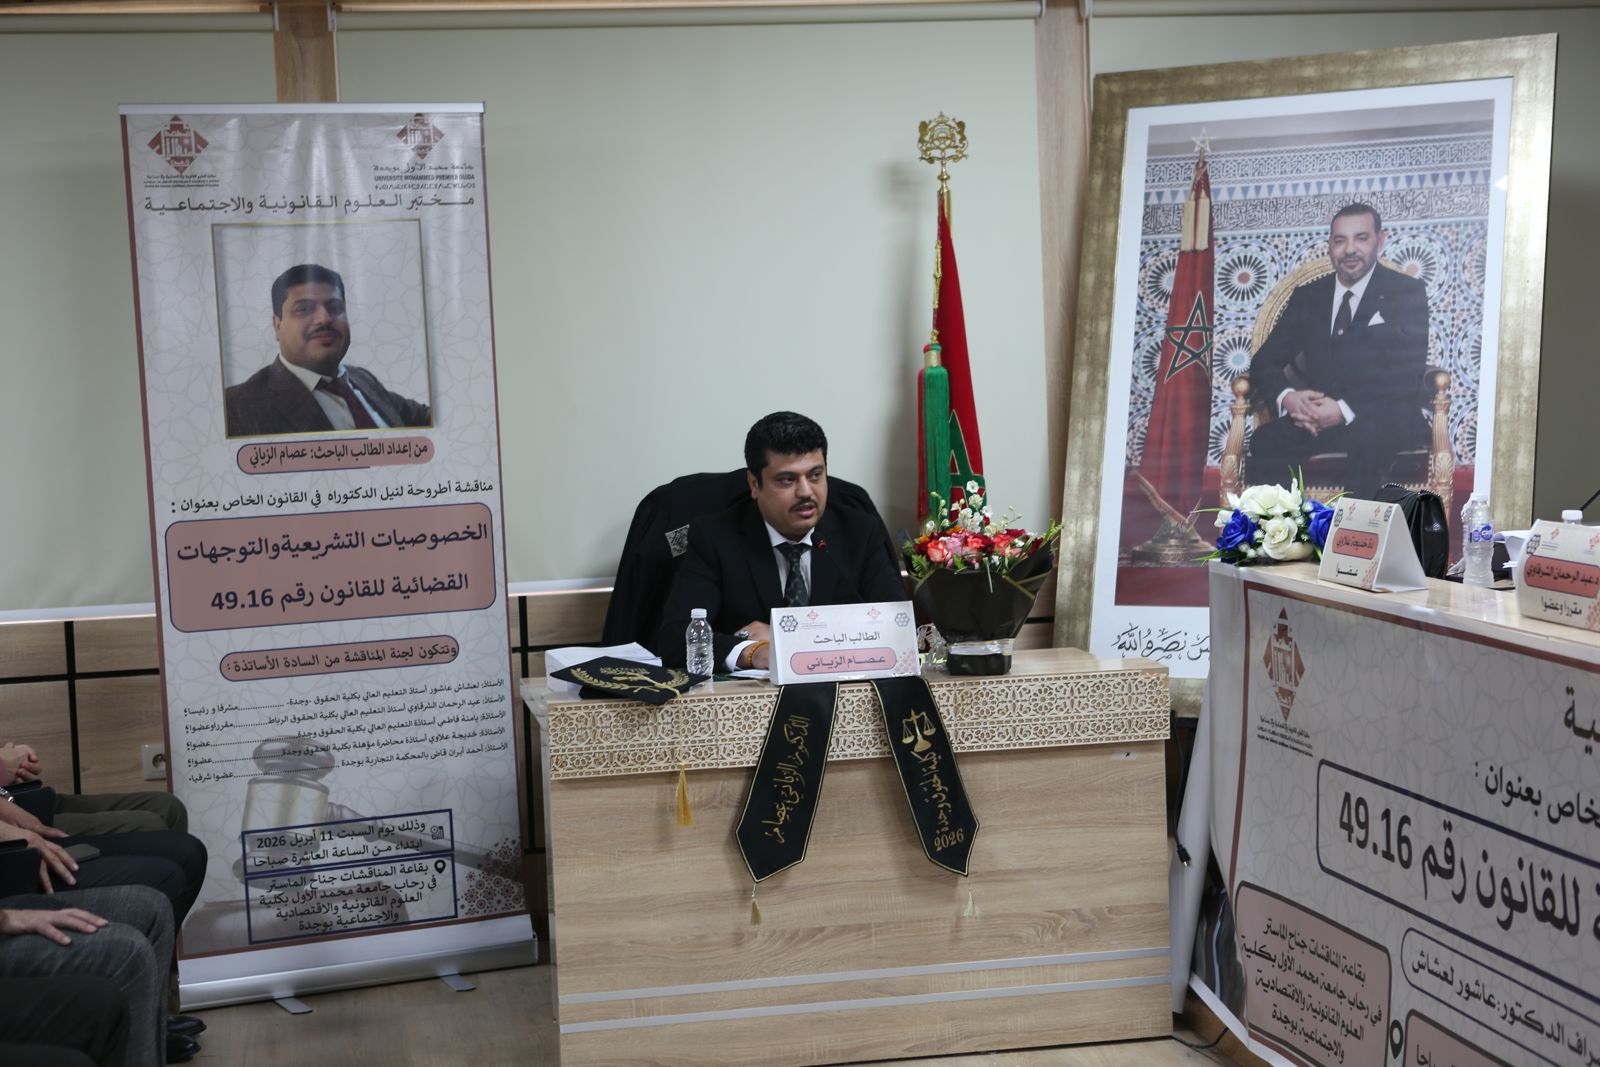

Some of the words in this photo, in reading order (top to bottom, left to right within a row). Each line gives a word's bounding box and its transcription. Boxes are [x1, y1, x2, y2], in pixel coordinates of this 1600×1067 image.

[144, 196, 254, 215] والاجتماعية
[259, 194, 338, 214] القانونية
[344, 193, 402, 214] العلوم
[406, 194, 475, 210] مختبر
[249, 447, 277, 468] الزياني
[279, 446, 308, 465] عصام
[310, 444, 348, 462] الباحث:
[350, 443, 385, 461] الطالب
[387, 442, 412, 458] إعداد
[415, 443, 428, 458] من
[380, 486, 404, 501] لنيل
[407, 480, 452, 498] أطروحة
[454, 479, 493, 493] مناقشة
[222, 494, 264, 511] الخاص
[267, 491, 308, 508] القانون
[311, 490, 322, 508] في
[327, 486, 377, 504] الدكتوراه
[180, 499, 219, 513] بعنوان
[371, 523, 488, 551] الخصوصيات
[320, 579, 385, 606] للقانون
[392, 573, 469, 599] القضائية
[211, 588, 274, 610] 49.16
[280, 582, 314, 612] رقم
[813, 633, 847, 645] الباحث
[848, 631, 881, 645] الطالب
[344, 649, 385, 663] المناقشة
[390, 646, 414, 660] لجنة
[419, 643, 457, 658] وتتكون
[234, 656, 279, 672] الأساتذة
[283, 655, 320, 668] السادة
[324, 654, 340, 667] من
[807, 656, 846, 672] الزياني
[847, 655, 886, 668] عصام
[342, 692, 361, 701] بكلية
[362, 691, 380, 701] العالي
[382, 688, 407, 699] التعليم
[409, 685, 427, 695] أستاذ
[430, 685, 452, 695] عاشور
[313, 695, 341, 705] الحقوق
[387, 703, 406, 713] أستاذ
[290, 713, 318, 723] الحقوق
[319, 710, 338, 720] بكلية
[340, 709, 358, 720] العالي
[360, 707, 386, 717] التعليم
[318, 726, 346, 737] الحقوق
[347, 725, 365, 735] بكلية
[367, 723, 386, 734] العالي
[387, 720, 412, 731] التعليم
[303, 745, 331, 756] الحقوق
[332, 743, 351, 752] بكلية
[1485, 765, 1542, 817] بعنوان
[1547, 792, 1600, 829] خاص
[337, 825, 374, 840] السبت
[378, 826, 395, 837] يوم
[398, 819, 426, 832] وذلك
[1339, 791, 1413, 870] 49.16
[256, 835, 286, 848] 2026
[289, 829, 317, 847] أبريل
[320, 830, 334, 841] 11
[933, 827, 965, 852] 2026
[291, 849, 328, 866] العاشرة
[332, 845, 369, 857] الساعة
[372, 844, 392, 856] من
[253, 856, 288, 868] صباحا
[400, 862, 429, 875] بقاعة
[1422, 819, 1467, 904] رقم
[340, 865, 397, 881] المناقشات
[266, 876, 306, 893] الماستر
[310, 874, 337, 889] جناح
[356, 881, 391, 894] جامعة
[394, 879, 425, 892] رحاب
[428, 874, 437, 891] في
[259, 893, 289, 908] بكلية
[292, 888, 317, 904] الأول
[320, 888, 353, 899] محمد
[390, 892, 423, 908] العلوم
[1476, 849, 1580, 936] للقانون
[276, 902, 339, 920] والاقتصادية
[342, 896, 387, 913] القانونية
[298, 920, 333, 932] بوجدة
[336, 909, 399, 928] والاجتماعية
[1263, 918, 1288, 941] الماستر
[1288, 929, 1308, 950] جناح
[1241, 935, 1277, 968] بكلية
[1309, 939, 1341, 969] المناقشات
[1278, 951, 1295, 972] الأول
[1412, 950, 1454, 986] لعشاش
[1296, 964, 1319, 984] محمد
[1341, 956, 1366, 987] بقاعة
[1255, 968, 1305, 1012] والاقتصادية
[1320, 972, 1347, 1004] جامعة
[1456, 978, 1496, 1009] عاشور
[1306, 993, 1341, 1026] القانونية
[1347, 992, 1369, 1019] رحاب
[1272, 1003, 1298, 1036] بوجدة
[1370, 1004, 1382, 1028] في
[1340, 1018, 1364, 1041] العلوم
[1299, 1018, 1345, 1064] والاجتماعية
[1567, 1031, 1600, 1067] راف
